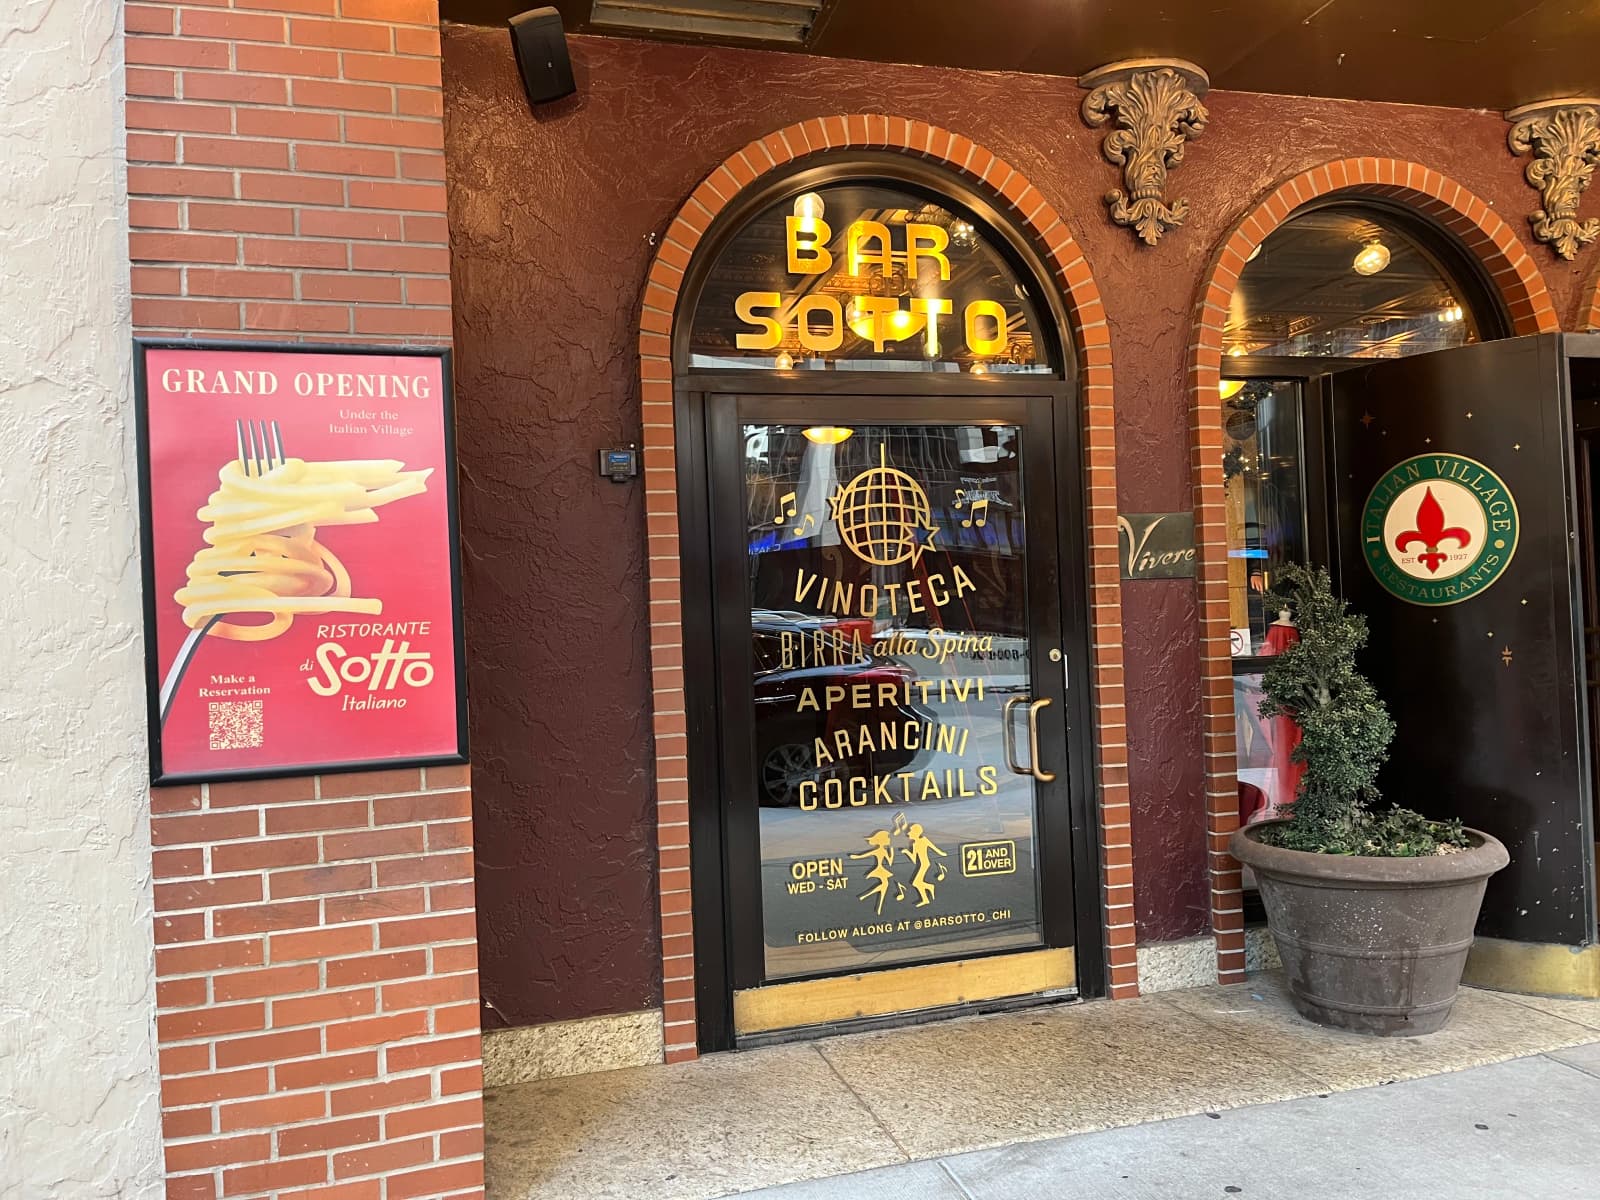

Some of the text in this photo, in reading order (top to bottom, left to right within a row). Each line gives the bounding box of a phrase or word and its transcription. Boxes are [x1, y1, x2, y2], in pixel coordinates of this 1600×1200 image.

[786, 215, 950, 281] BAR
[735, 292, 1007, 355] SOTTO
[162, 368, 431, 399] GRAND OPENING
[329, 423, 414, 436] Italian Village
[339, 409, 399, 421] Under the
[1366, 460, 1511, 544] ITALIAN VILLAGE
[1117, 515, 1196, 577] Vivere
[795, 565, 976, 617] VINOTECA
[1380, 554, 1499, 598] RESTAURANTS
[317, 622, 431, 638] RISTORANTE
[781, 627, 992, 669] BIRRA alla Spina
[210, 674, 245, 685] Make
[300, 639, 434, 696] di Sotto
[199, 686, 271, 697] Reservation
[341, 694, 407, 712] Italiano
[797, 678, 984, 712] APERITIVI
[815, 721, 969, 767] ARANCINI
[799, 766, 998, 811] COCKTAILS
[792, 858, 843, 880] OPEN
[967, 848, 1008, 871] 21 AND
[983, 858, 1011, 869] OVER
[787, 881, 816, 895] WED
[826, 877, 848, 890] SAT
[798, 910, 1011, 943] FOLLOW ALONG AT @BARSOTTO_CHI
